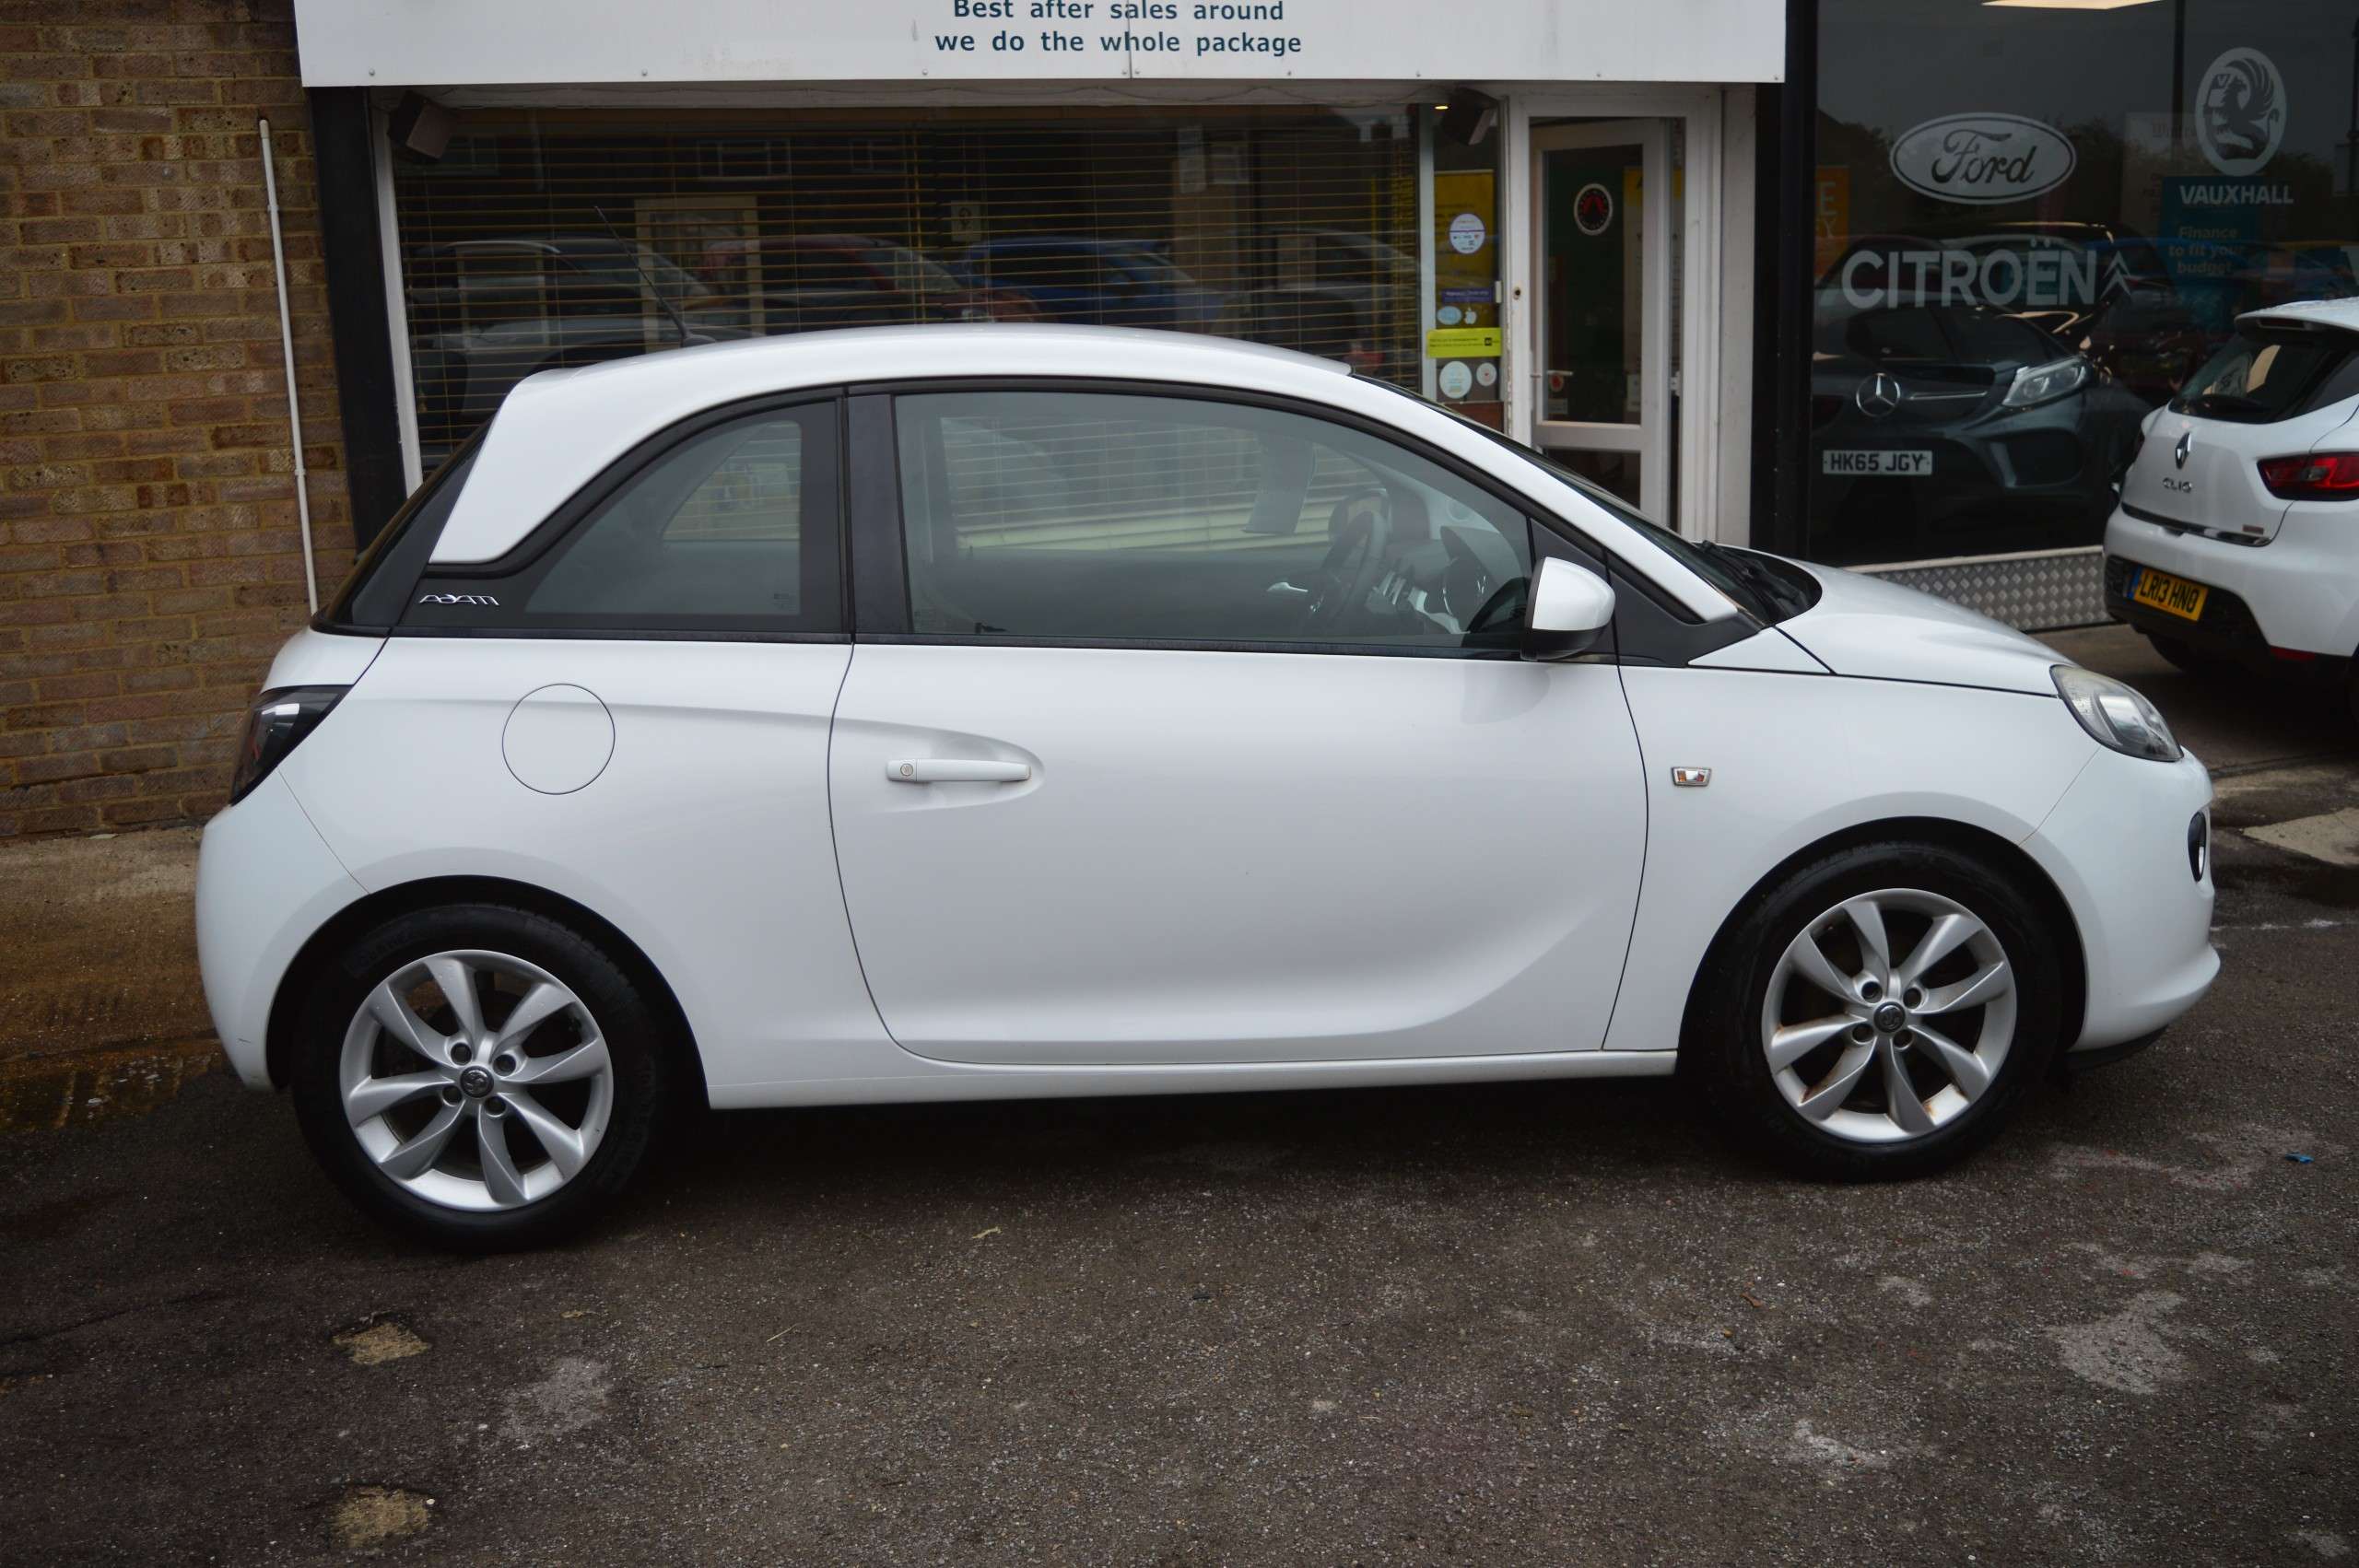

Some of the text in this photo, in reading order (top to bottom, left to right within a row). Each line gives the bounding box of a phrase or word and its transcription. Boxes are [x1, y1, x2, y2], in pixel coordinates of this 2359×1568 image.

[954, 0, 1284, 20] Best after sales around
[934, 30, 1302, 56] we do the whole package
[1931, 129, 2037, 184] Ford
[2178, 184, 2294, 205] VAUXHALL
[2178, 226, 2238, 239] Finance
[2167, 245, 2183, 258] to
[2188, 244, 2206, 258] fit
[1841, 237, 2097, 309] CITROËN
[1830, 452, 1924, 472] HK65 JGY
[2162, 477, 2193, 494] CLIO
[2139, 572, 2171, 603] LR13
